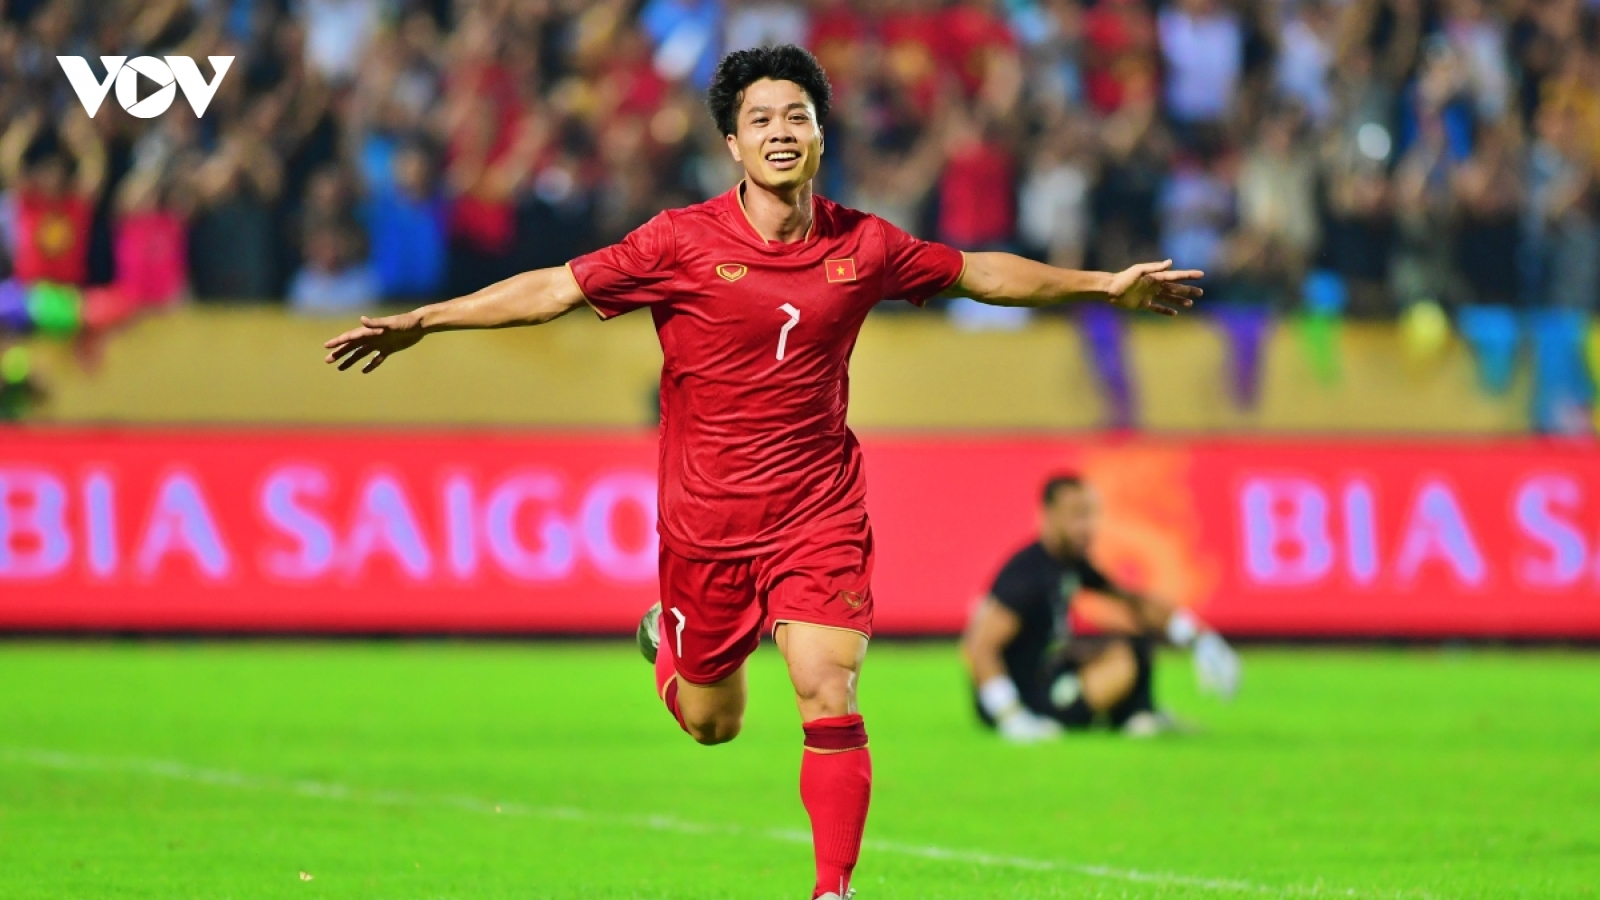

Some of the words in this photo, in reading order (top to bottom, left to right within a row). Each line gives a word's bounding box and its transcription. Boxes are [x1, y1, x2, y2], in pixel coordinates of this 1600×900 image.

[776, 302, 800, 361] 7
[0, 468, 231, 582] BIA
[1239, 475, 1486, 589] BIA
[1517, 474, 1600, 588] S
[670, 607, 686, 658] 7
